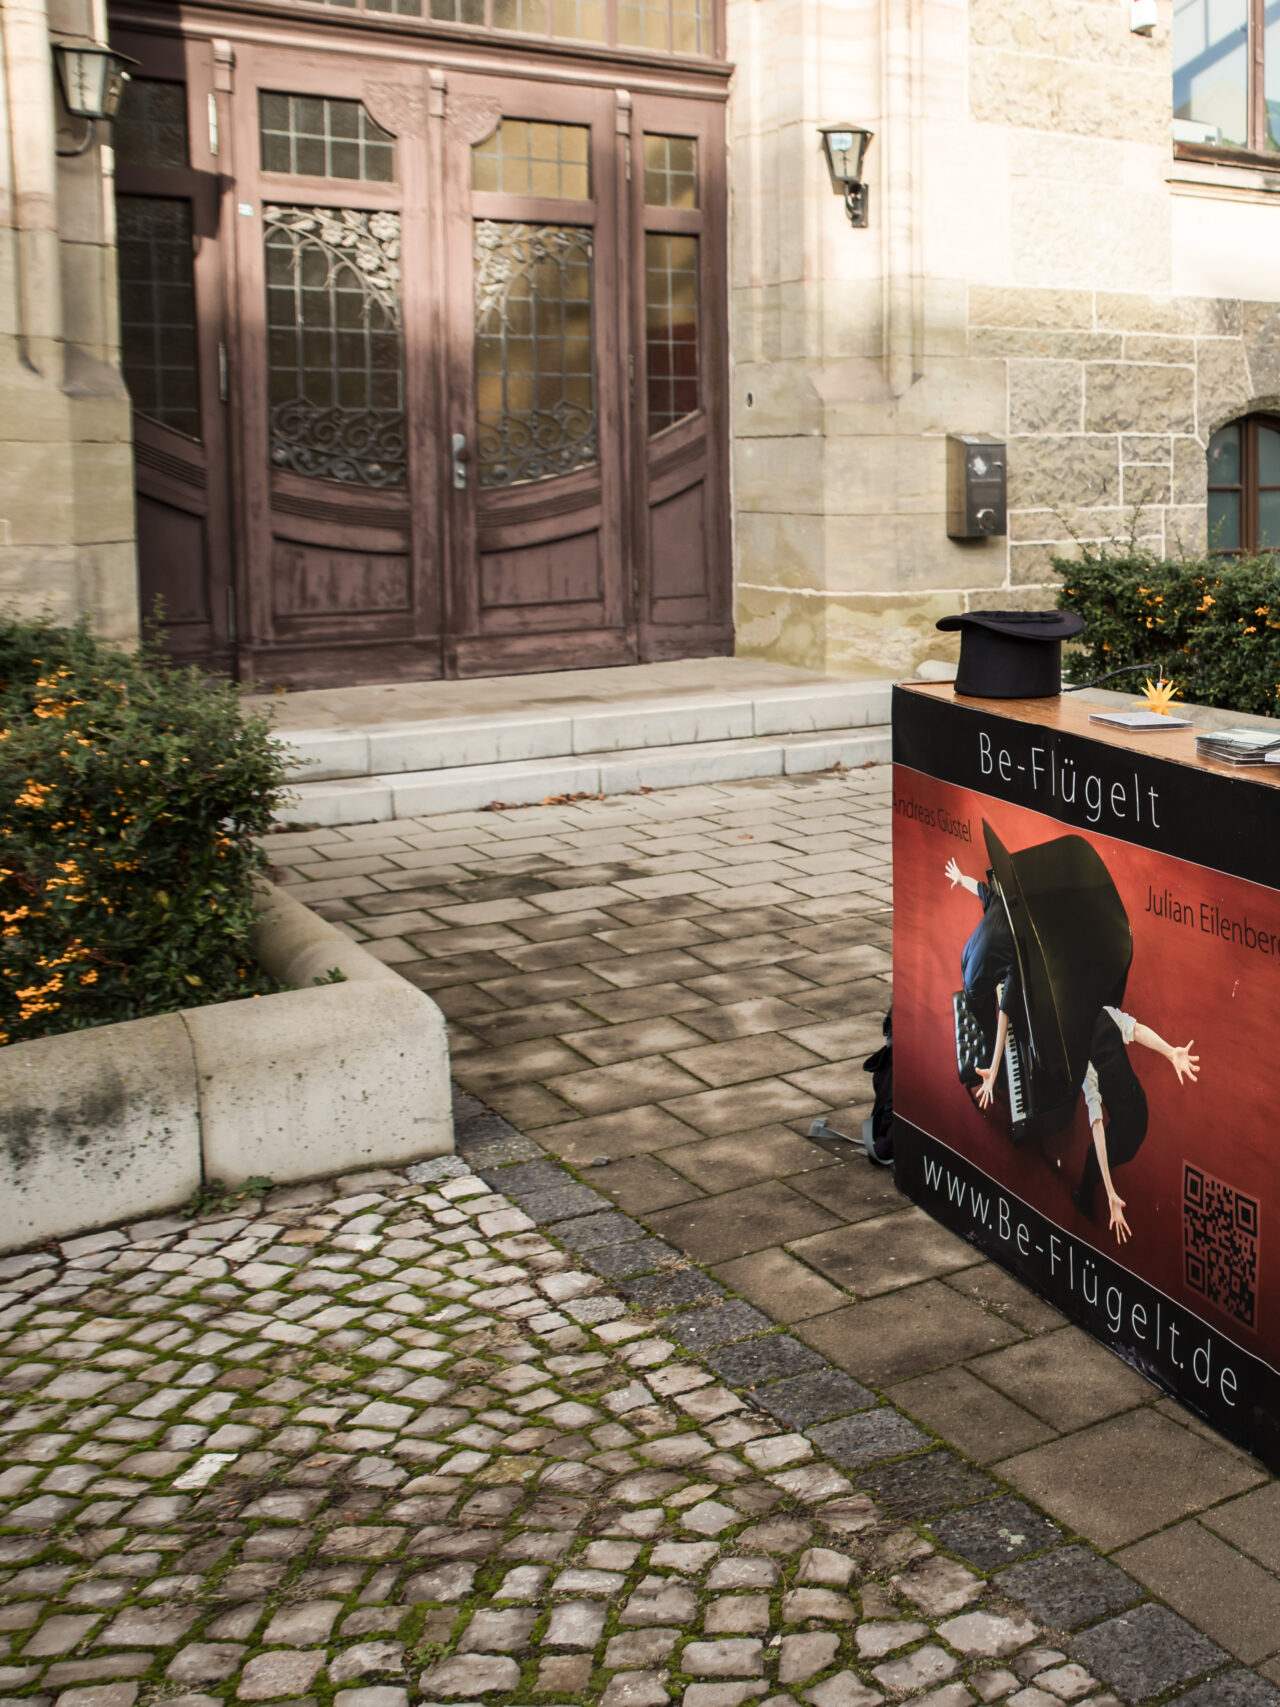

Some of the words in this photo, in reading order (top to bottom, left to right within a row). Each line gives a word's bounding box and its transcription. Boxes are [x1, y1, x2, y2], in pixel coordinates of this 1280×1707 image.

[979, 732, 1160, 829] Be-Flügelt
[937, 807, 972, 844] Güstel
[1145, 885, 1194, 928] Julian
[923, 1155, 1238, 1407] www.Be-Flügelt.de
